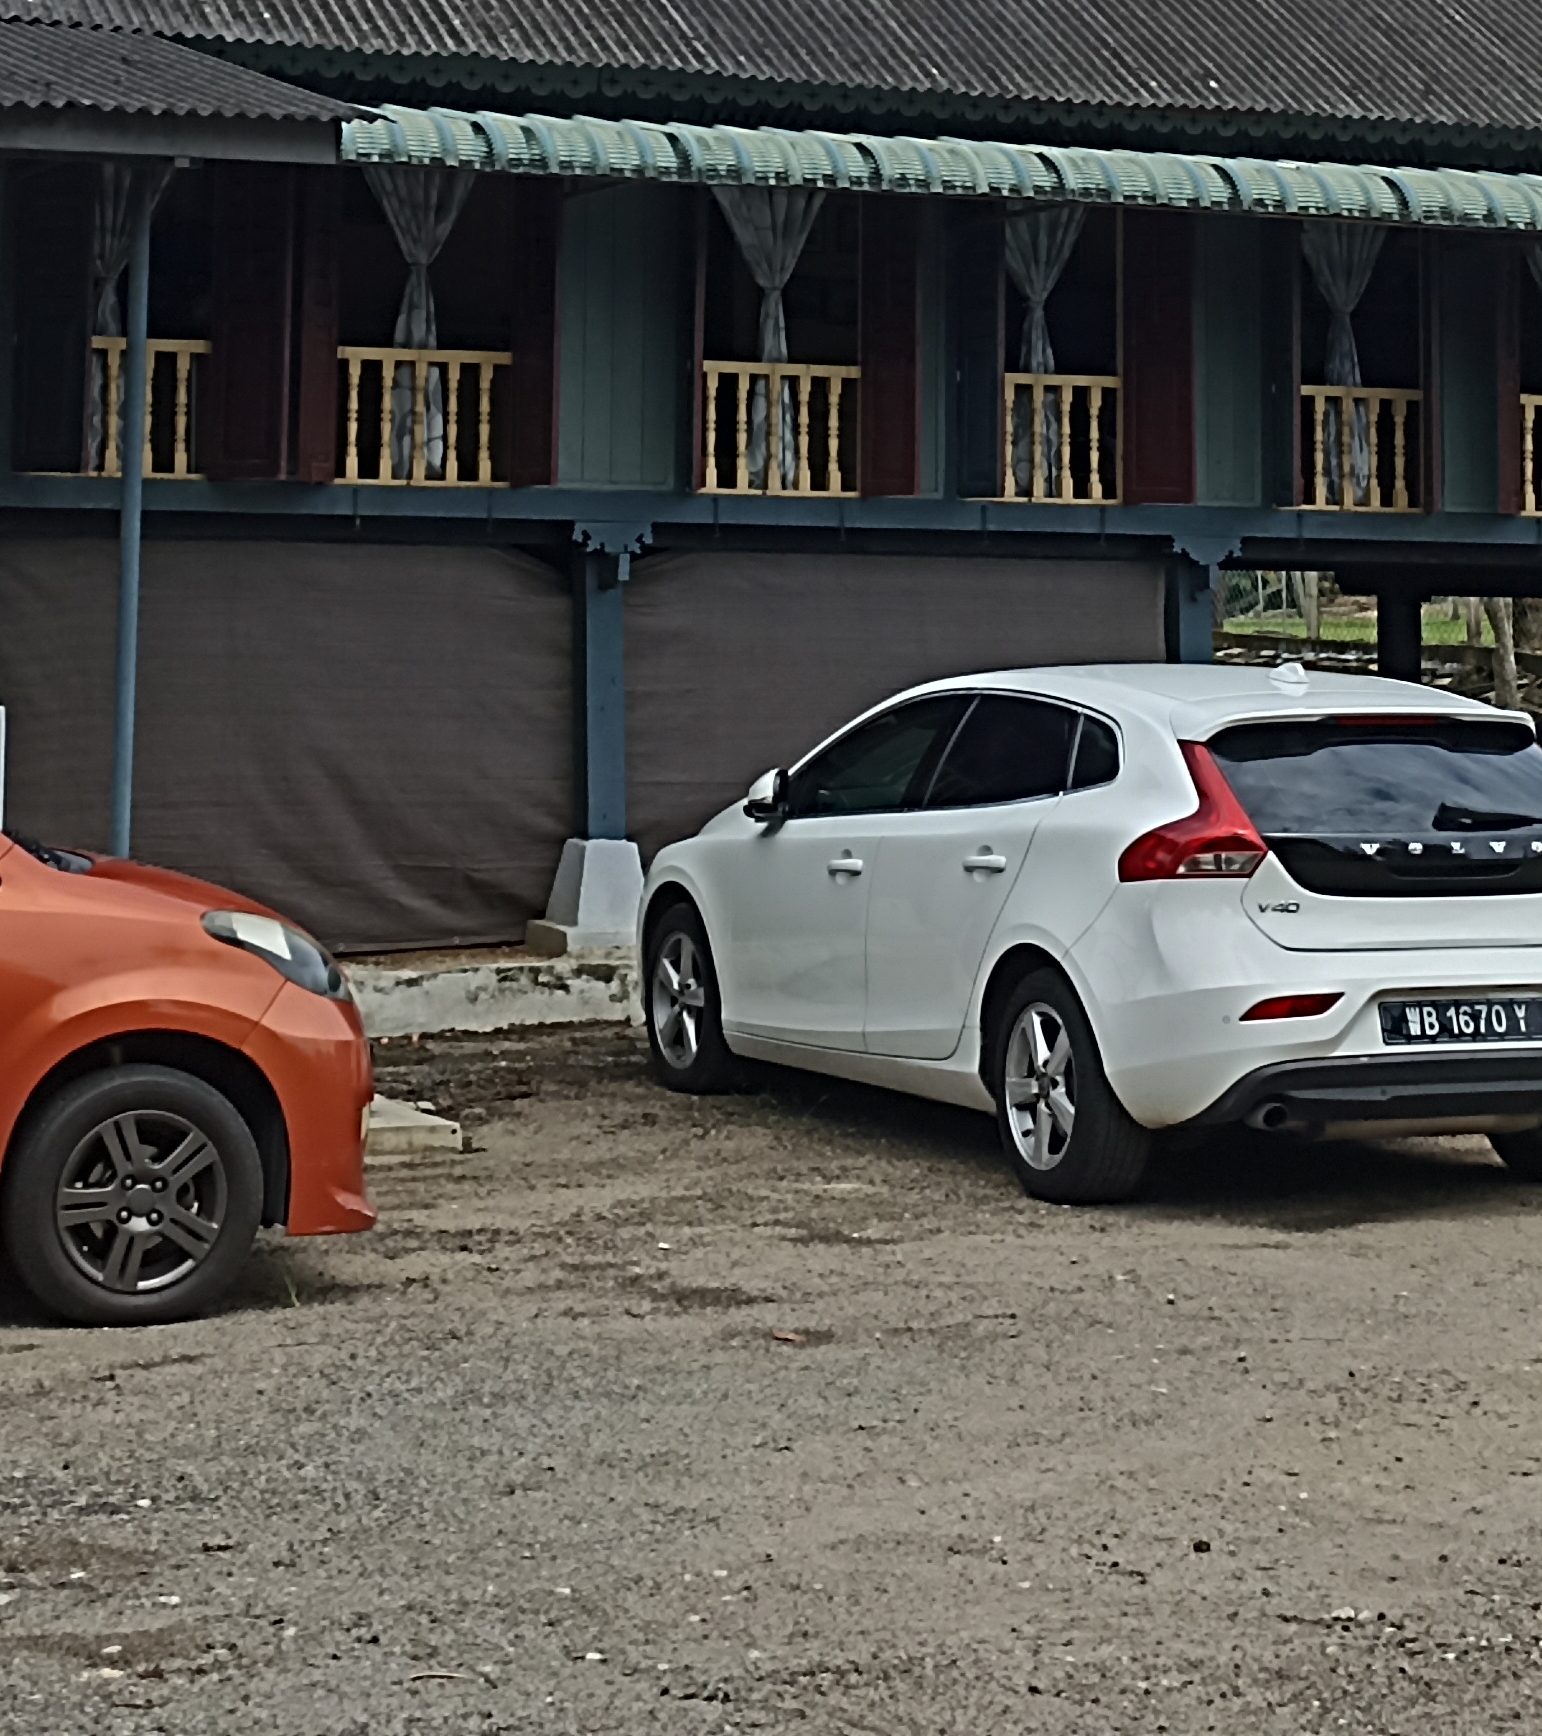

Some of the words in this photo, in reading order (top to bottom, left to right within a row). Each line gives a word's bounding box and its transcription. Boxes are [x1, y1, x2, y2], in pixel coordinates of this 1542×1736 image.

[1258, 902, 1300, 913] V40
[1405, 1006, 1440, 1036] WB
[1446, 1004, 1507, 1035] 1670
[1513, 1003, 1527, 1033] Y
